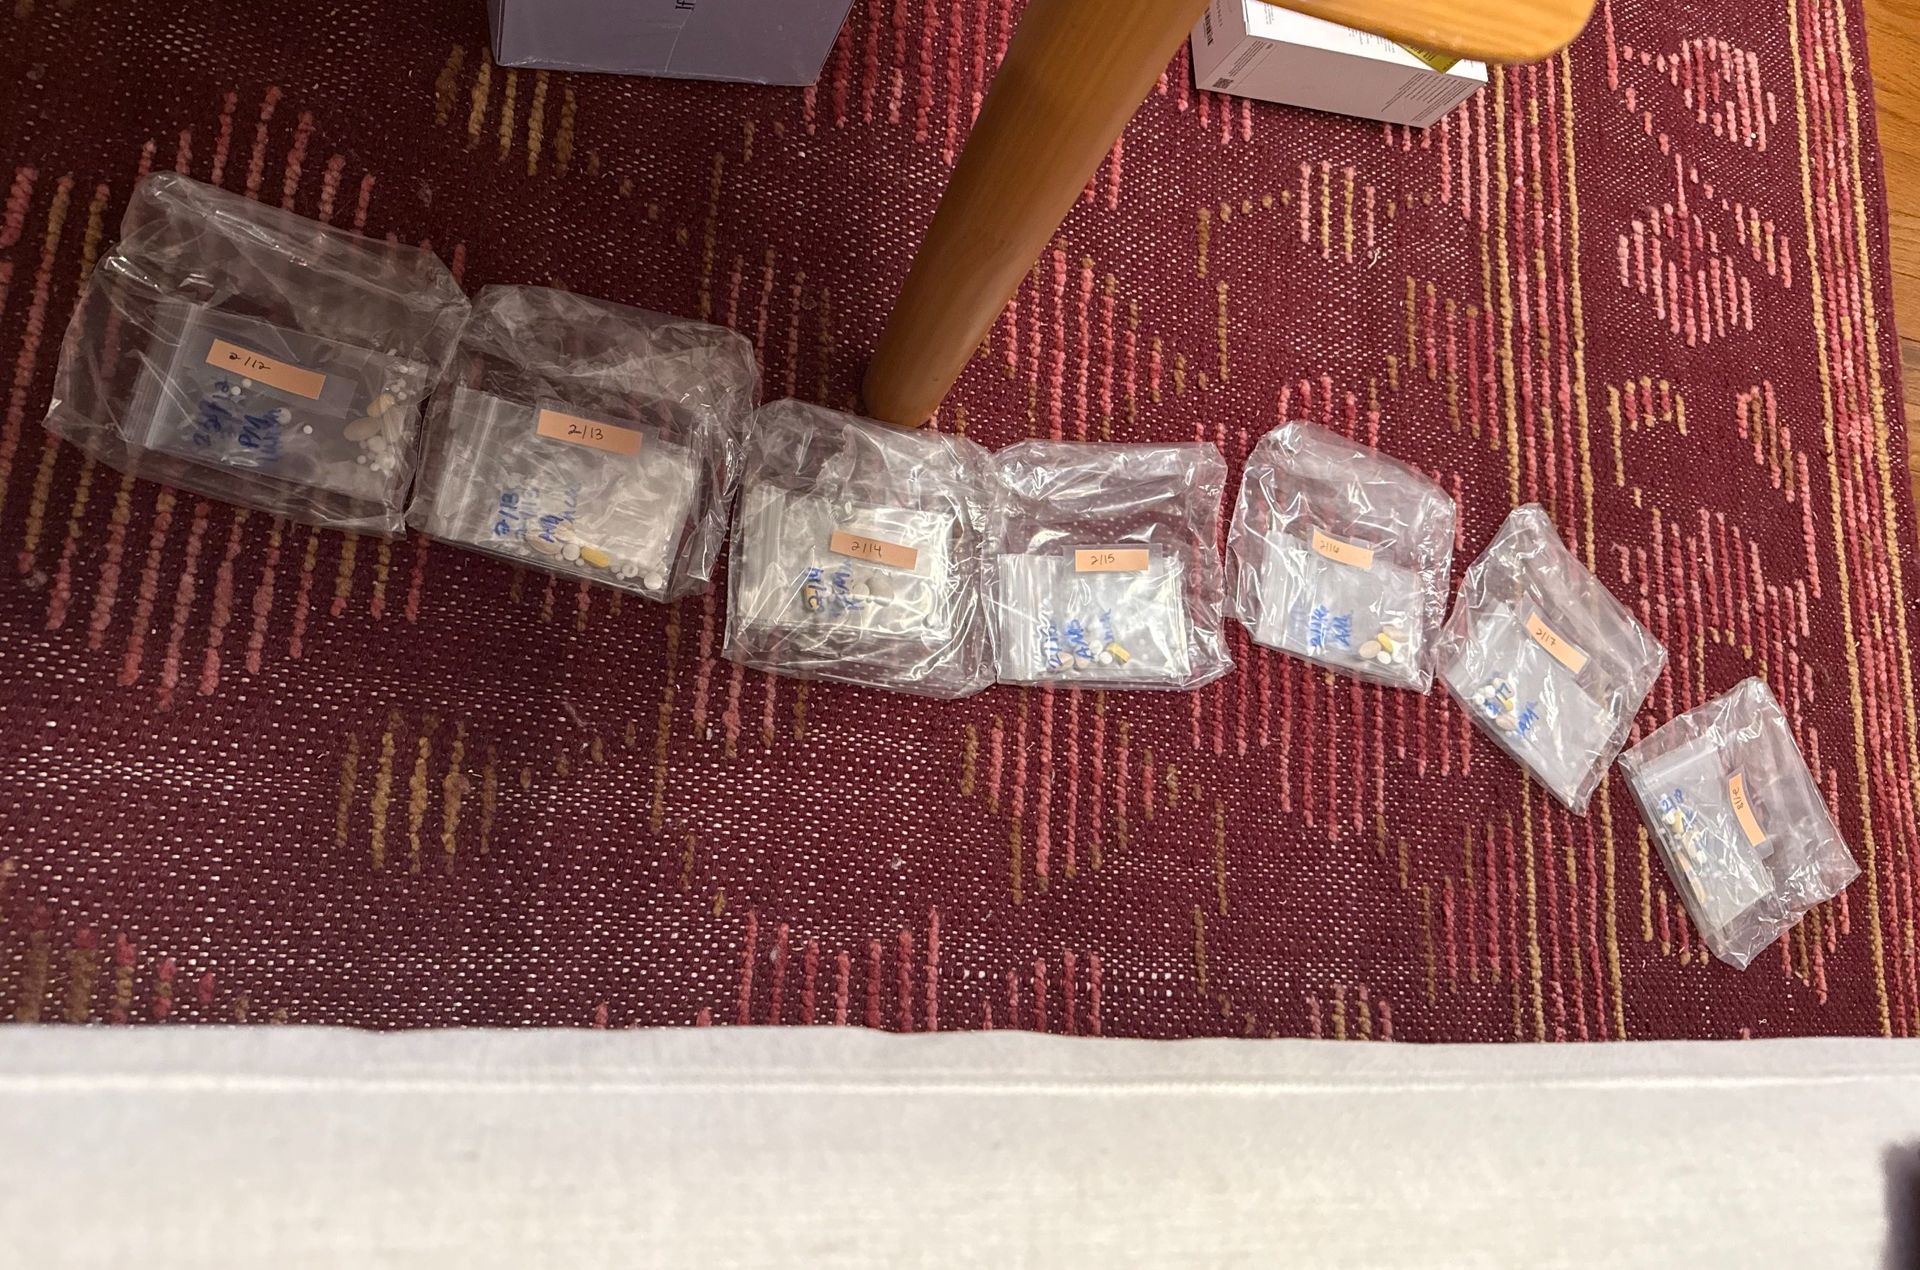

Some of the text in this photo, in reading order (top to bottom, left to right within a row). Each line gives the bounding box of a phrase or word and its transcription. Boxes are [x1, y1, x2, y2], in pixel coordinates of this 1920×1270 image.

[228, 352, 271, 370] 2/12
[567, 424, 604, 440] 2/13
[851, 541, 882, 558] 2/14
[1090, 553, 1115, 566] 2/15
[1536, 628, 1556, 646] 2/17
[1732, 787, 1744, 810] 2/18
